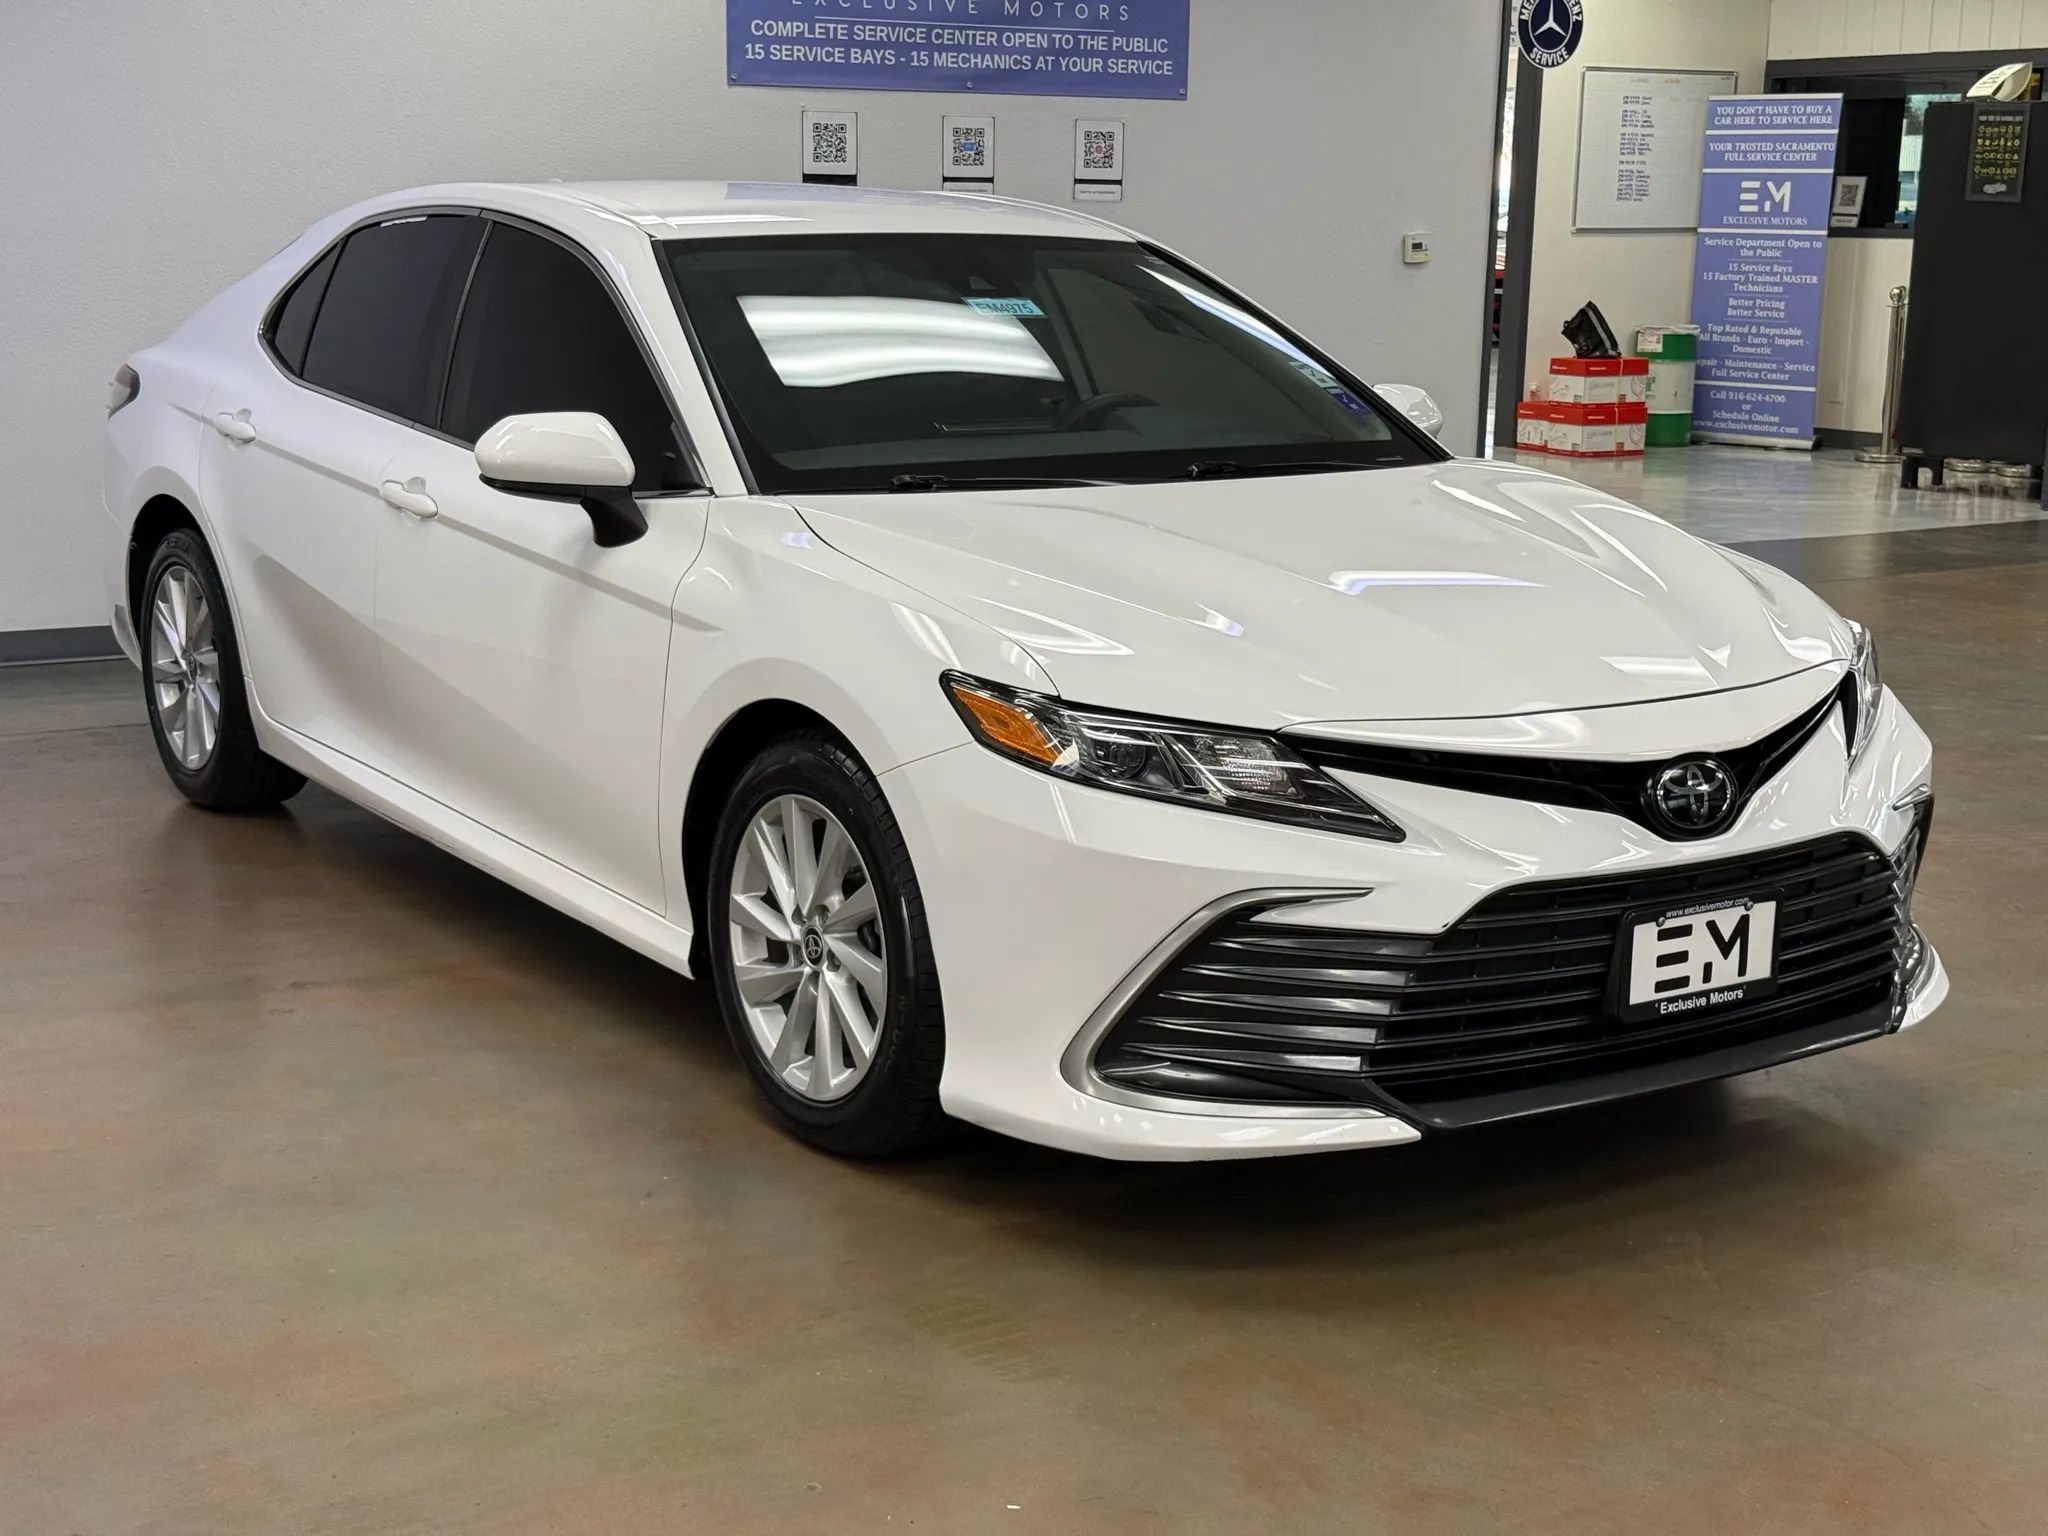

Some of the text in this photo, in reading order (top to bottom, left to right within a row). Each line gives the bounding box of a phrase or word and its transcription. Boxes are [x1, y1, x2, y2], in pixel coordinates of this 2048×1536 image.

[1004, 1, 1128, 21] MOTORS
[751, 20, 1168, 53] COMPLETE SERVICE CENTER OPEN TO THE PUBLIC
[745, 43, 765, 60] 15
[769, 45, 845, 63] SERVICE
[850, 48, 896, 65] BAYS
[911, 51, 929, 67] 15
[934, 52, 1031, 71] MECHANICS
[1035, 56, 1055, 71] AT
[1059, 57, 1102, 73] YOUR
[1107, 59, 1173, 75] SERVICE
[1530, 47, 1569, 66] SERVICE
[1716, 105, 1832, 115] YOU DON'T HAVE TO BUY A
[1714, 115, 1833, 125] CAR HERE TO SERVICE HERE
[1709, 142, 1835, 151] YOUR TRUSTED SACRAMENTO
[1724, 152, 1817, 161] FULL SERVICE CENTER
[1739, 181, 1791, 212] EM
[1723, 216, 1808, 226] EXCLUSIVE MOTORS
[1704, 237, 1822, 249] Service Department Open to
[1740, 248, 1782, 257] the Public
[1728, 263, 1792, 273] 15 Service Bays
[1703, 272, 1818, 284] 15 Factory Trained MASTER
[1733, 283, 1783, 293] Technicians
[1728, 297, 1786, 309] Better Pricing
[1727, 307, 1784, 318] Better Service
[1707, 323, 1802, 336] Top Rated & Reputable
[1699, 333, 1710, 341] All
[1712, 333, 1740, 342] Brands
[1748, 335, 1767, 344] Euro
[1775, 336, 1804, 347] Import
[1733, 345, 1772, 354] Domestic
[1696, 359, 1718, 368] epair
[1724, 359, 1777, 369] Maintenance
[1784, 362, 1816, 372] Service
[1711, 368, 1791, 380] Full Service Center
[1710, 390, 1726, 399] Call
[1712, 410, 1780, 423] Schedule Online
[1694, 420, 1800, 434] www.exclusivemotor.com
[1665, 897, 1750, 919] www.exclusivemotor.com
[1654, 913, 1750, 993] EM
[1660, 988, 1743, 1014] Exclusive Motors
